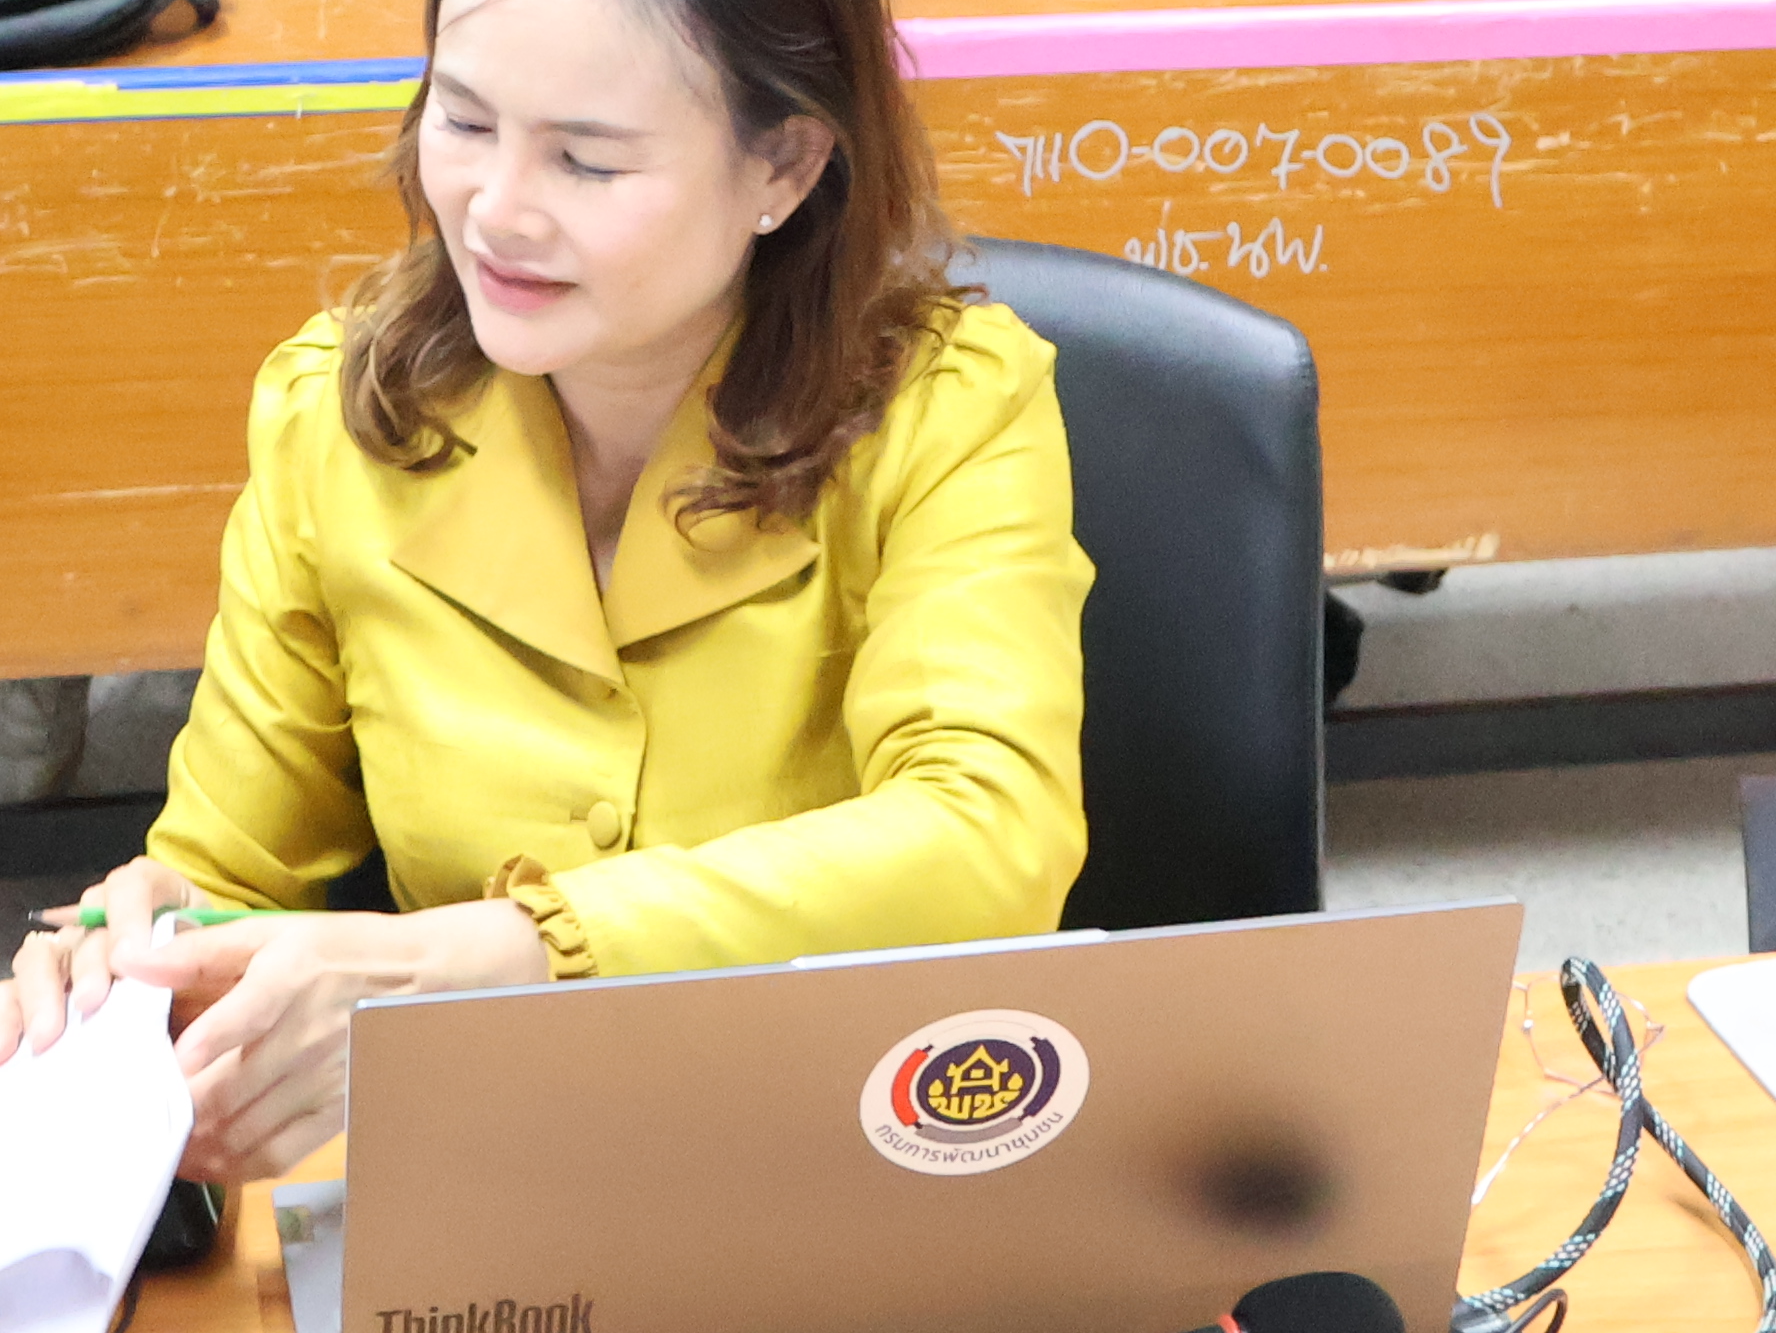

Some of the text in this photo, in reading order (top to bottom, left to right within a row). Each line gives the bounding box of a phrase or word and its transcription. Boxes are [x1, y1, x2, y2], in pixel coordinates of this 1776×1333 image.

[875, 1112, 1064, 1164] กรมการพัฒนาชุมชน
